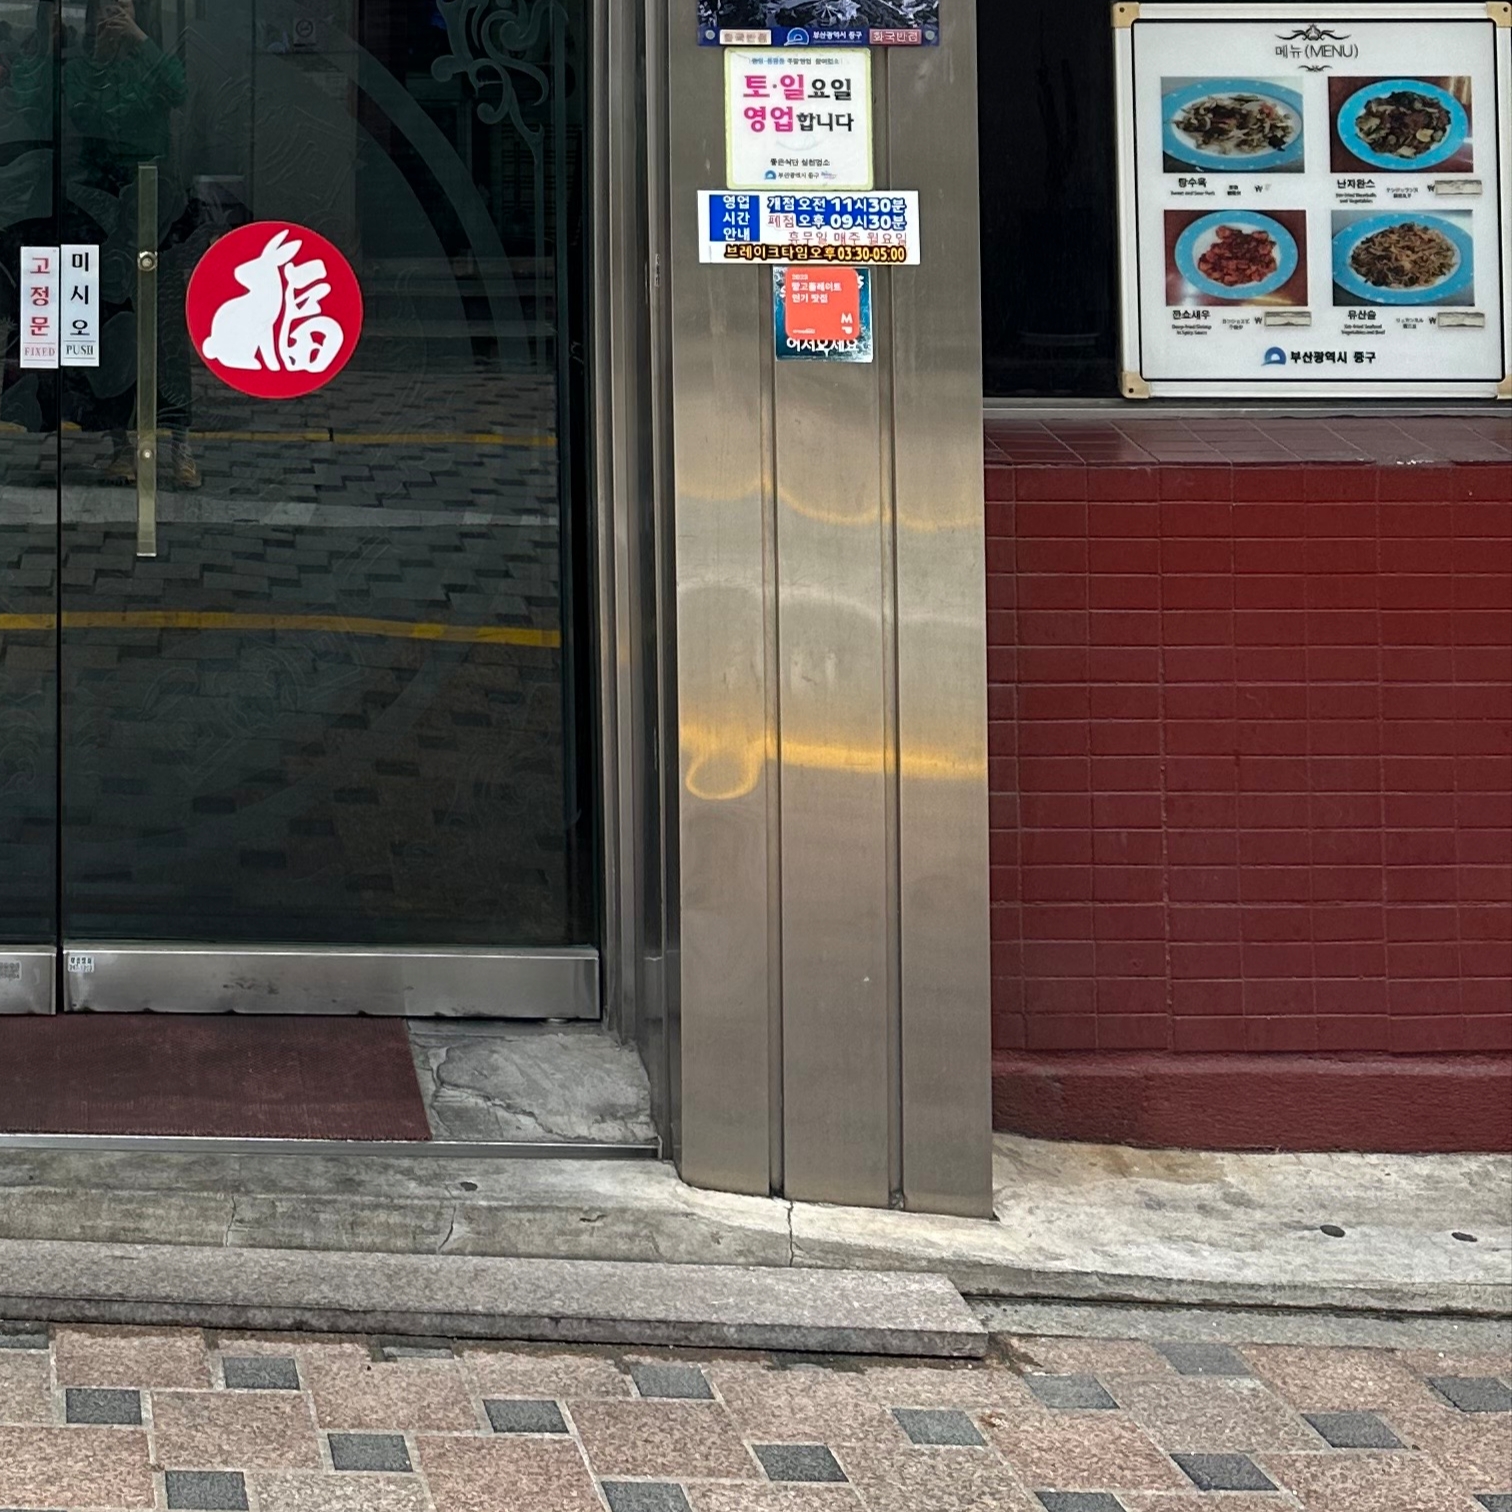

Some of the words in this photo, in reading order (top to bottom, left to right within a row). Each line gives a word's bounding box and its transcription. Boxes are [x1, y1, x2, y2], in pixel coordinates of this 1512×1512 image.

[812, 30, 847, 39] 부산광역시
[848, 31, 863, 39] 중구
[872, 31, 919, 43] 화국반점
[1275, 44, 1359, 59] 메뉴(MENU)
[743, 105, 855, 133] 영업합니다
[1178, 177, 1207, 188] 탕수육
[1336, 178, 1376, 189] 난자완스
[722, 195, 750, 209] 영업
[767, 196, 795, 212] 개점
[797, 197, 826, 212] 오전
[830, 197, 907, 214] 11시30분
[722, 213, 750, 226] 시간
[767, 214, 795, 228] 폐점
[797, 214, 826, 229] 오후
[829, 214, 907, 230] 09시30분
[722, 227, 750, 242] 안내
[788, 231, 829, 245] 휴무일
[833, 232, 861, 245] 매주
[866, 231, 907, 246] 월요일
[791, 282, 842, 292] 망고플레이트
[29, 256, 51, 337] 고정문
[69, 252, 91, 337] 미시오
[791, 293, 809, 303] 인기
[1348, 309, 1377, 320] 유산슬
[24, 346, 56, 357] FIXED
[65, 344, 94, 356] PUSH
[1290, 350, 1348, 364] 부산광역시
[1353, 350, 1376, 364] 중구
